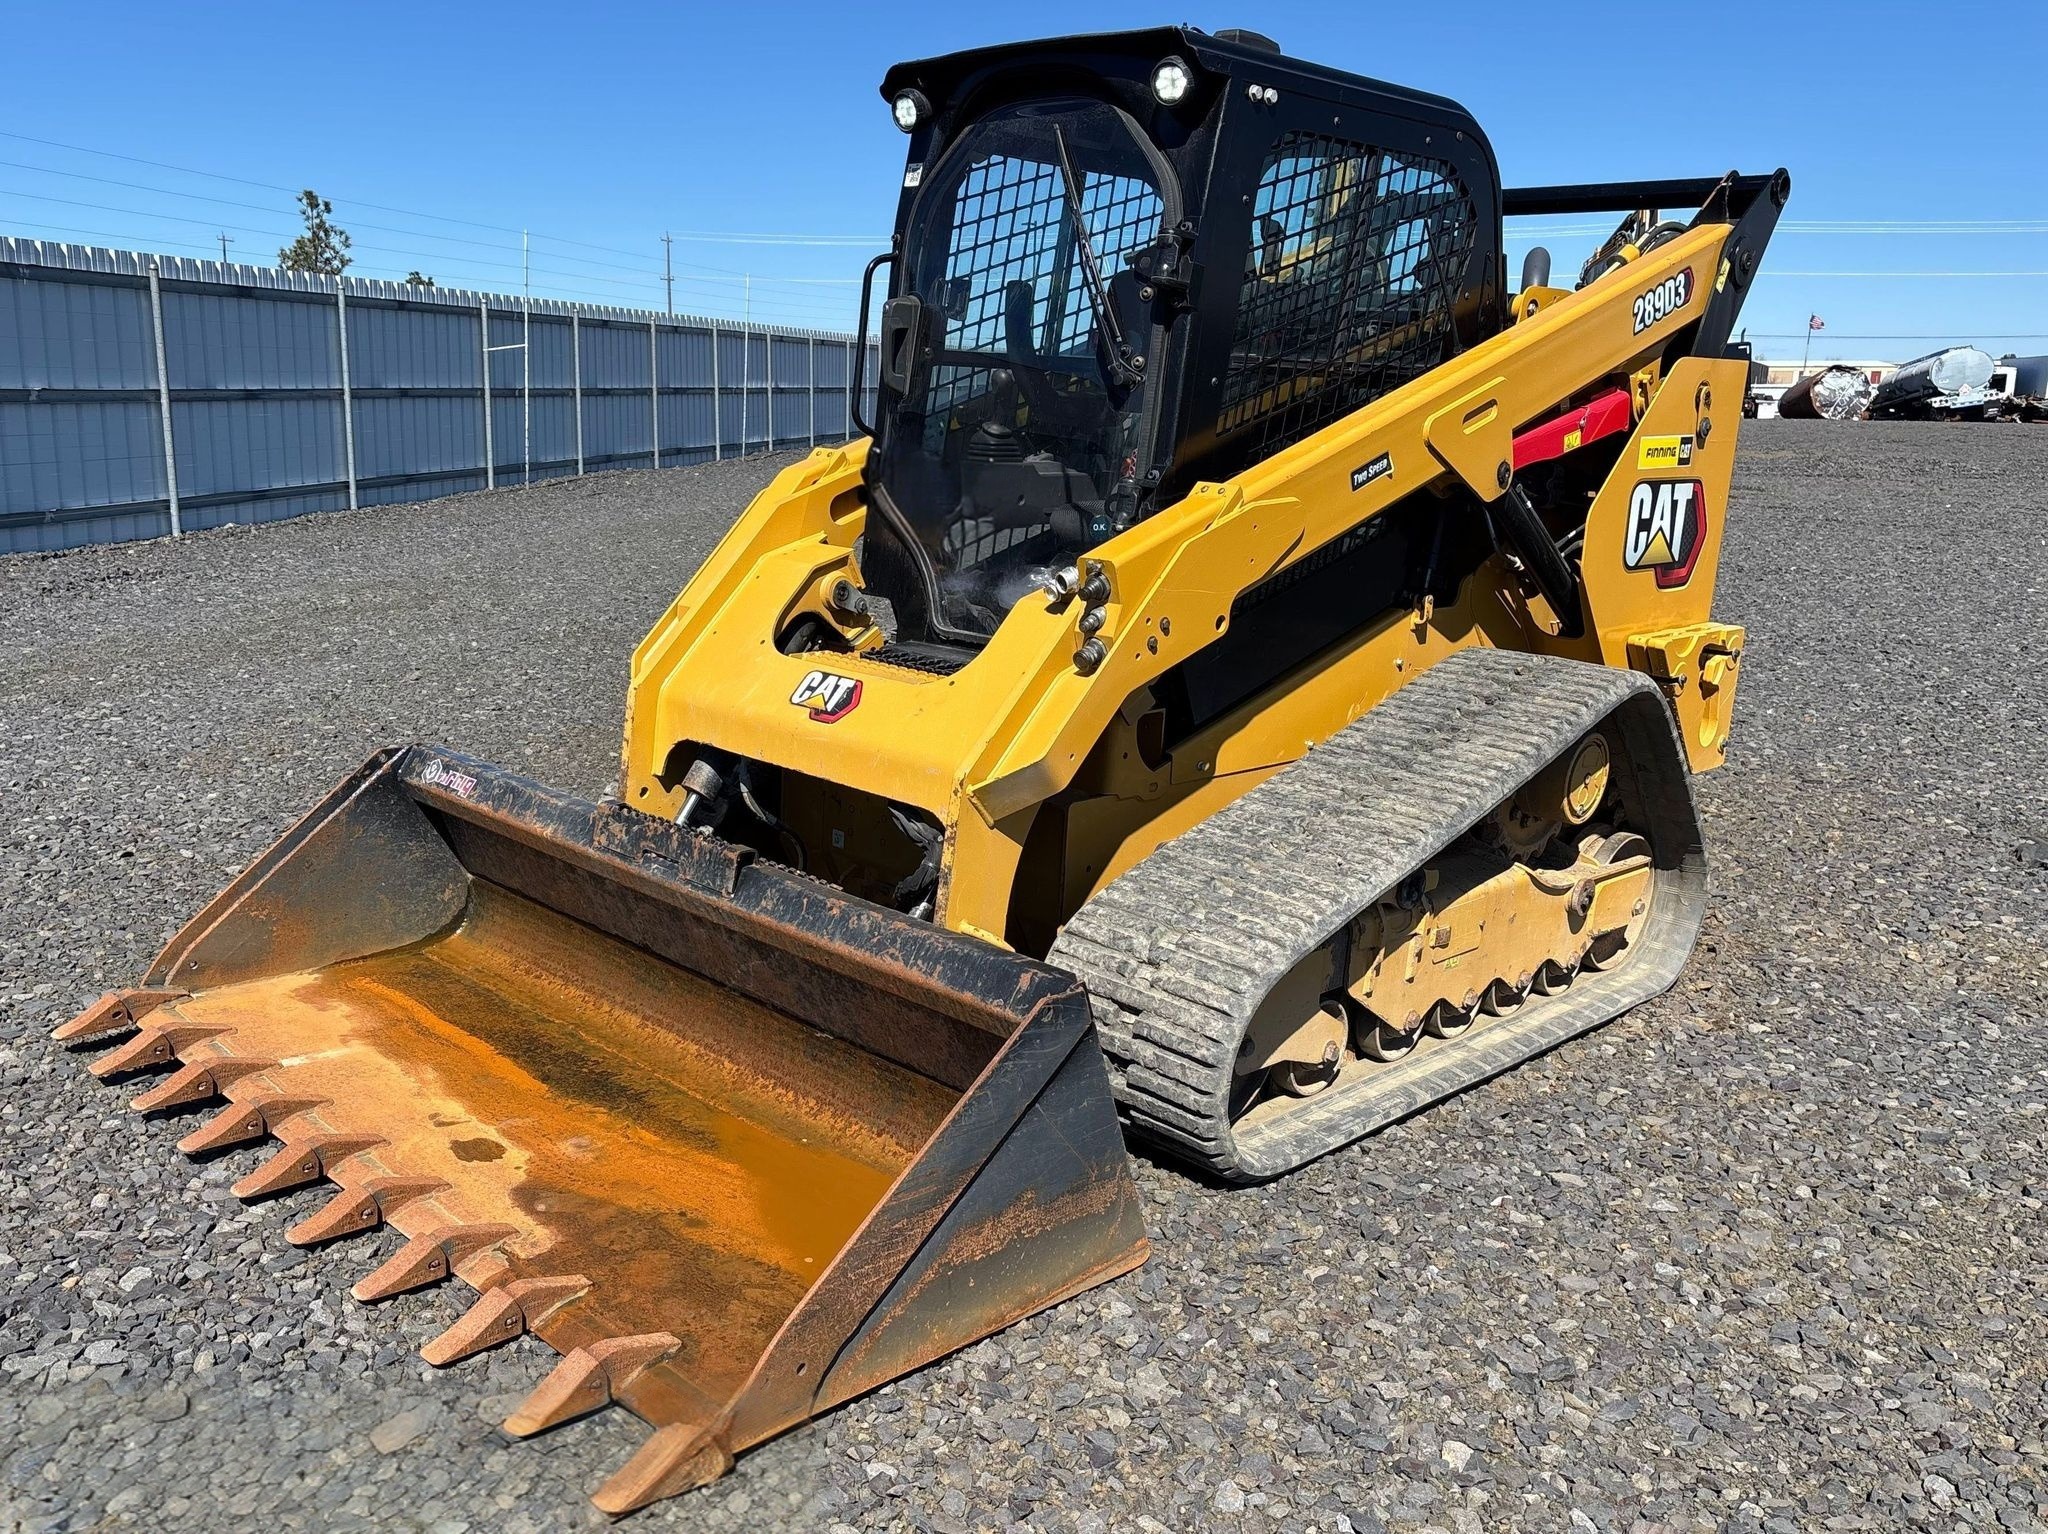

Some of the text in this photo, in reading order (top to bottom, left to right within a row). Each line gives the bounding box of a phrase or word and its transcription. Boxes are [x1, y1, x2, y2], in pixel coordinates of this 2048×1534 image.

[1633, 272, 1686, 334] 289D3
[1646, 443, 1692, 459] FINNING CAT
[1625, 482, 1694, 567] CAT
[791, 670, 857, 712] CAT
